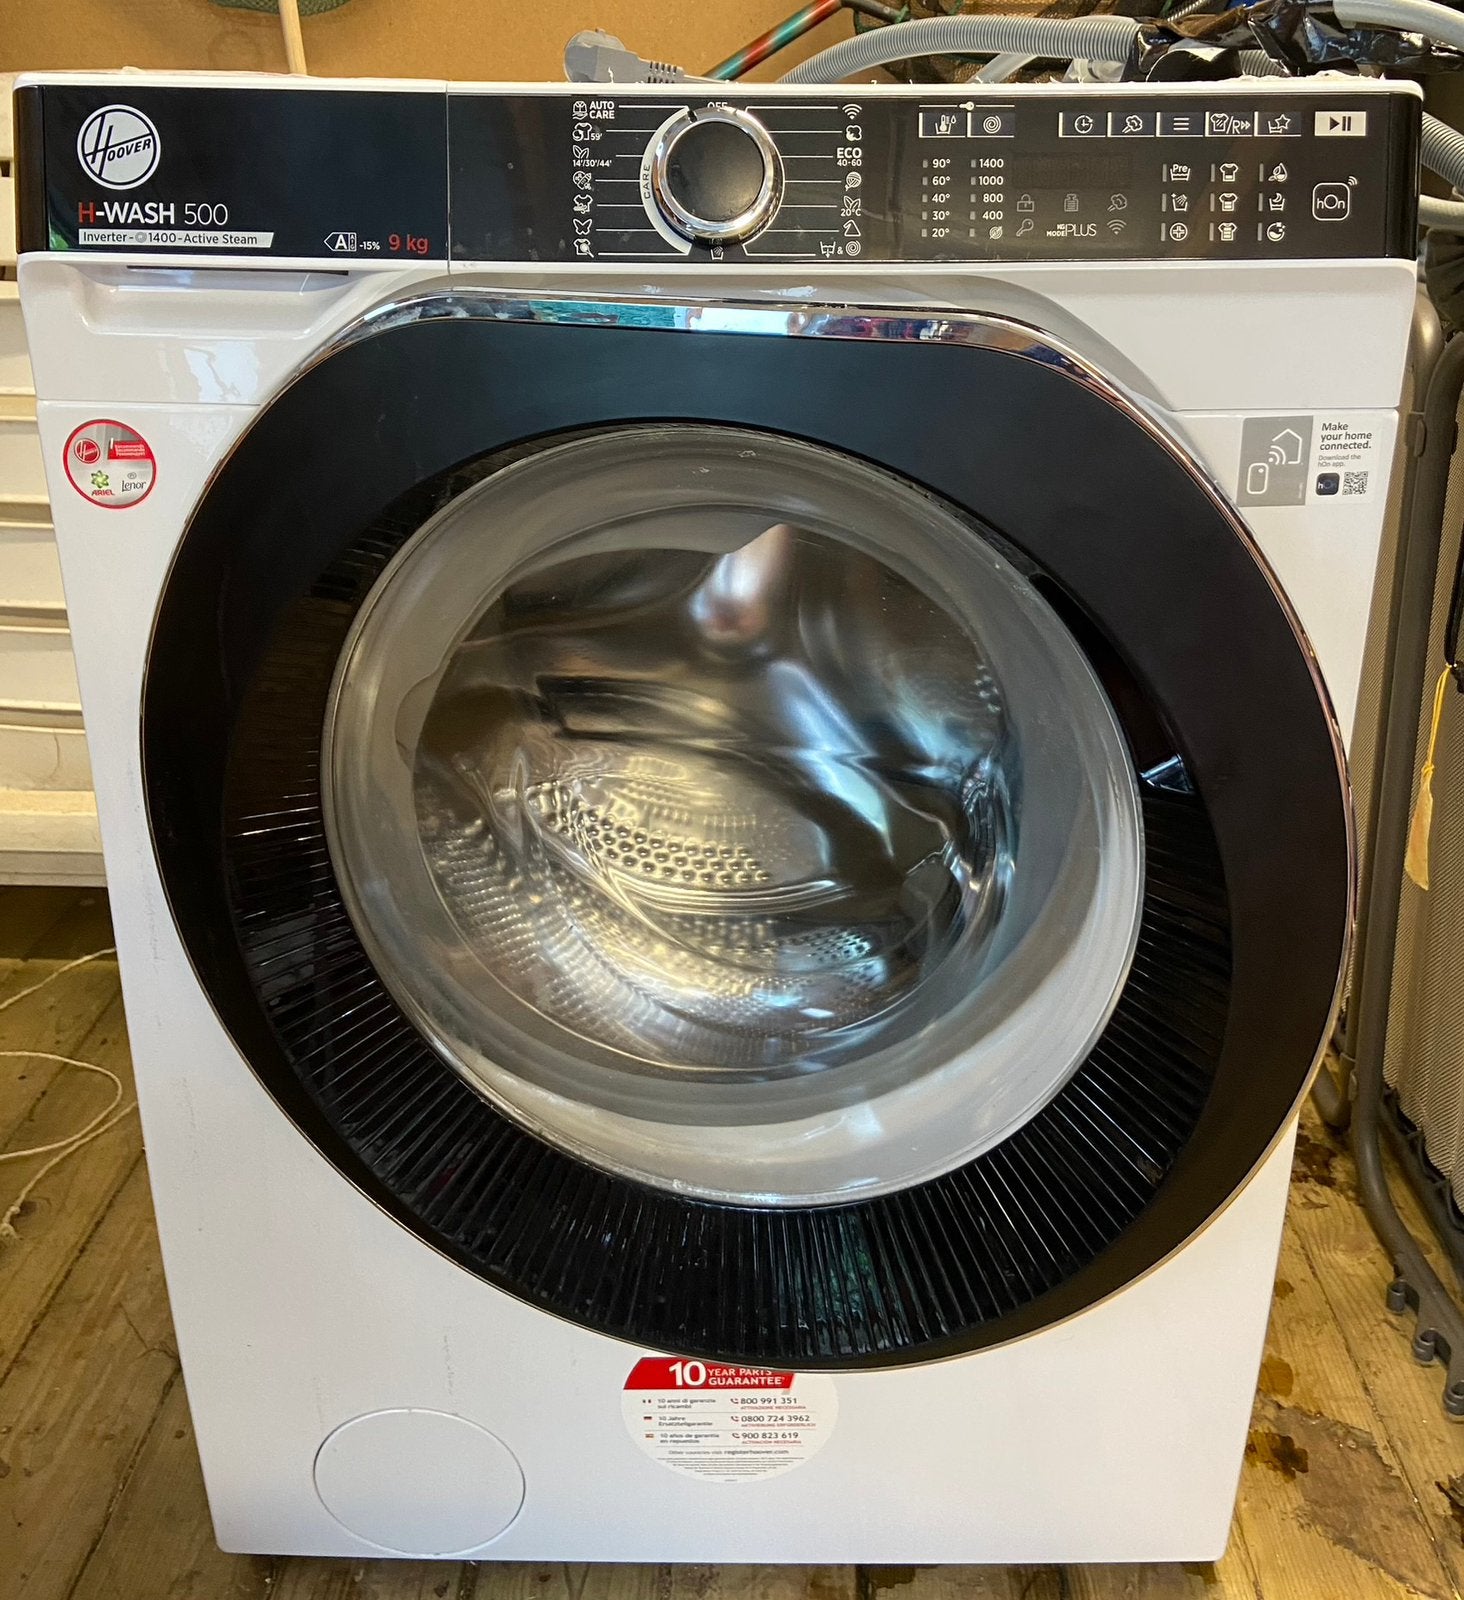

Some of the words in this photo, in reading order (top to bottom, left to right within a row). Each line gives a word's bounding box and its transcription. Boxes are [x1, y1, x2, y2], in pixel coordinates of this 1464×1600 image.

[589, 101, 615, 110] AUTO
[589, 110, 615, 120] CARE
[836, 147, 862, 159] ECO
[932, 158, 951, 168] 90°
[979, 158, 1004, 168] 1400
[1172, 164, 1188, 174] Pre
[643, 164, 651, 200] CARE
[932, 176, 951, 186] 60°
[978, 176, 1004, 186] 1000
[931, 193, 950, 203] 40°
[982, 193, 1004, 203] 800
[1316, 194, 1346, 210] hOn
[78, 201, 175, 225] H-WASH
[184, 203, 229, 226] 500
[840, 208, 862, 217] 20°C
[931, 211, 950, 220] 30°
[982, 211, 1004, 220] 400
[931, 228, 950, 238] 20°
[1065, 224, 1097, 237] PLUS
[222, 233, 258, 245] Steam
[334, 234, 348, 250] A
[359, 240, 380, 250] -15%
[388, 233, 401, 251] 9
[406, 233, 429, 254] kg
[1321, 422, 1349, 431] Make
[1320, 433, 1343, 442] your
[1344, 432, 1372, 441] home
[1319, 440, 1371, 451] connected.
[122, 480, 146, 493] Lenor
[91, 489, 115, 497] ARIEL
[669, 1361, 706, 1386] 10
[707, 1368, 735, 1376] YEAR
[740, 1397, 758, 1405] 800
